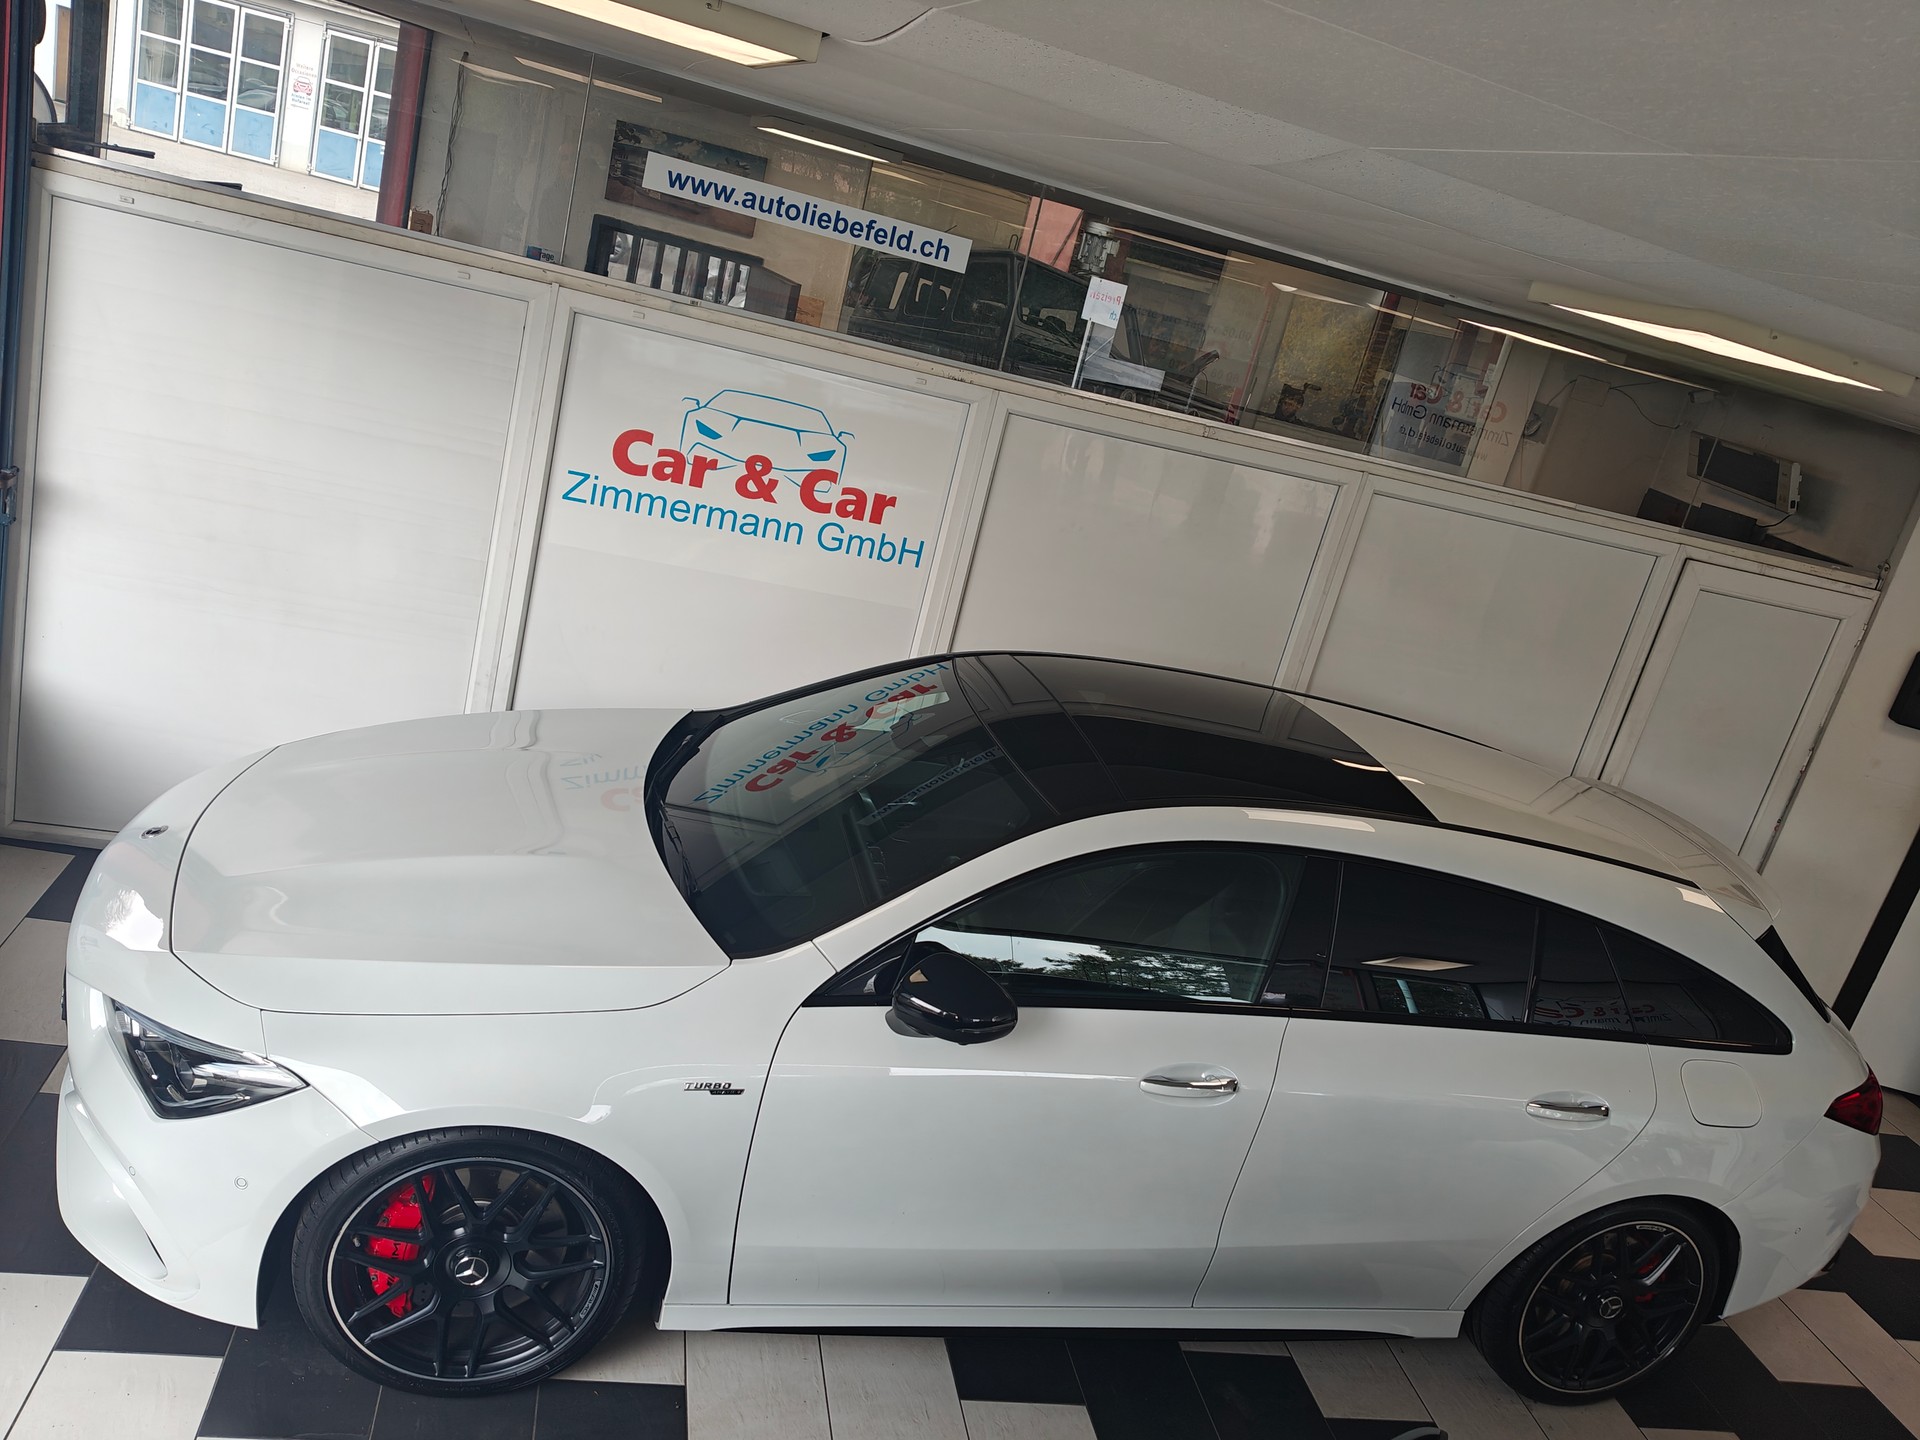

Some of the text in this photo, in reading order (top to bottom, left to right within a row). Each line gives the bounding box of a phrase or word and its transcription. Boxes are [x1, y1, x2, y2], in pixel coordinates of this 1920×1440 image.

[667, 168, 950, 261] www.autoliebefeld.ch
[562, 470, 925, 568] Zimmermann GmbH
[612, 428, 897, 525] Car & Car
